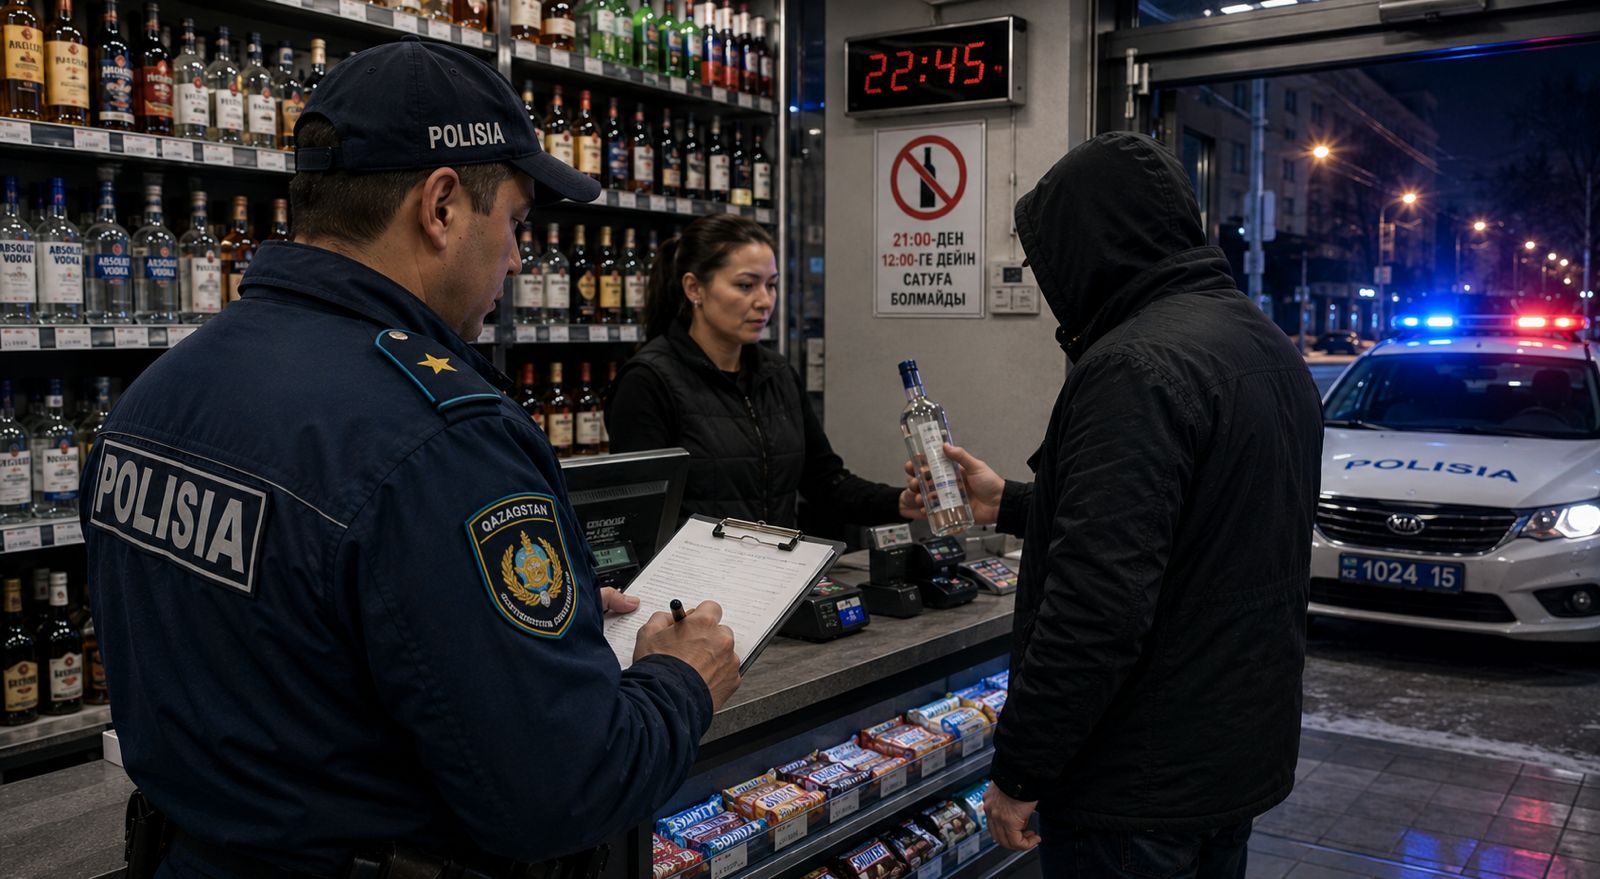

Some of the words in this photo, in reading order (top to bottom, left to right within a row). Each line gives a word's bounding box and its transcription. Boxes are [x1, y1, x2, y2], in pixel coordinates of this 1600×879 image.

[864, 42, 984, 94] 22:45
[428, 122, 506, 148] POLISIA
[893, 232, 963, 248] 21:00-ДЕН
[882, 253, 932, 267] 12:00-ГЕ
[936, 250, 975, 268] ДЕЙІН
[903, 272, 952, 286] САТУҒА
[891, 289, 965, 307] БОЛМАЙДЫ
[1344, 459, 1518, 483] POLISIA
[95, 453, 244, 574] POLISIA
[481, 503, 548, 533] QAZAGSTAN
[1391, 516, 1417, 531] KIA
[1342, 568, 1357, 579] KZ
[1362, 559, 1418, 585] 1024
[1430, 565, 1456, 588] 15
